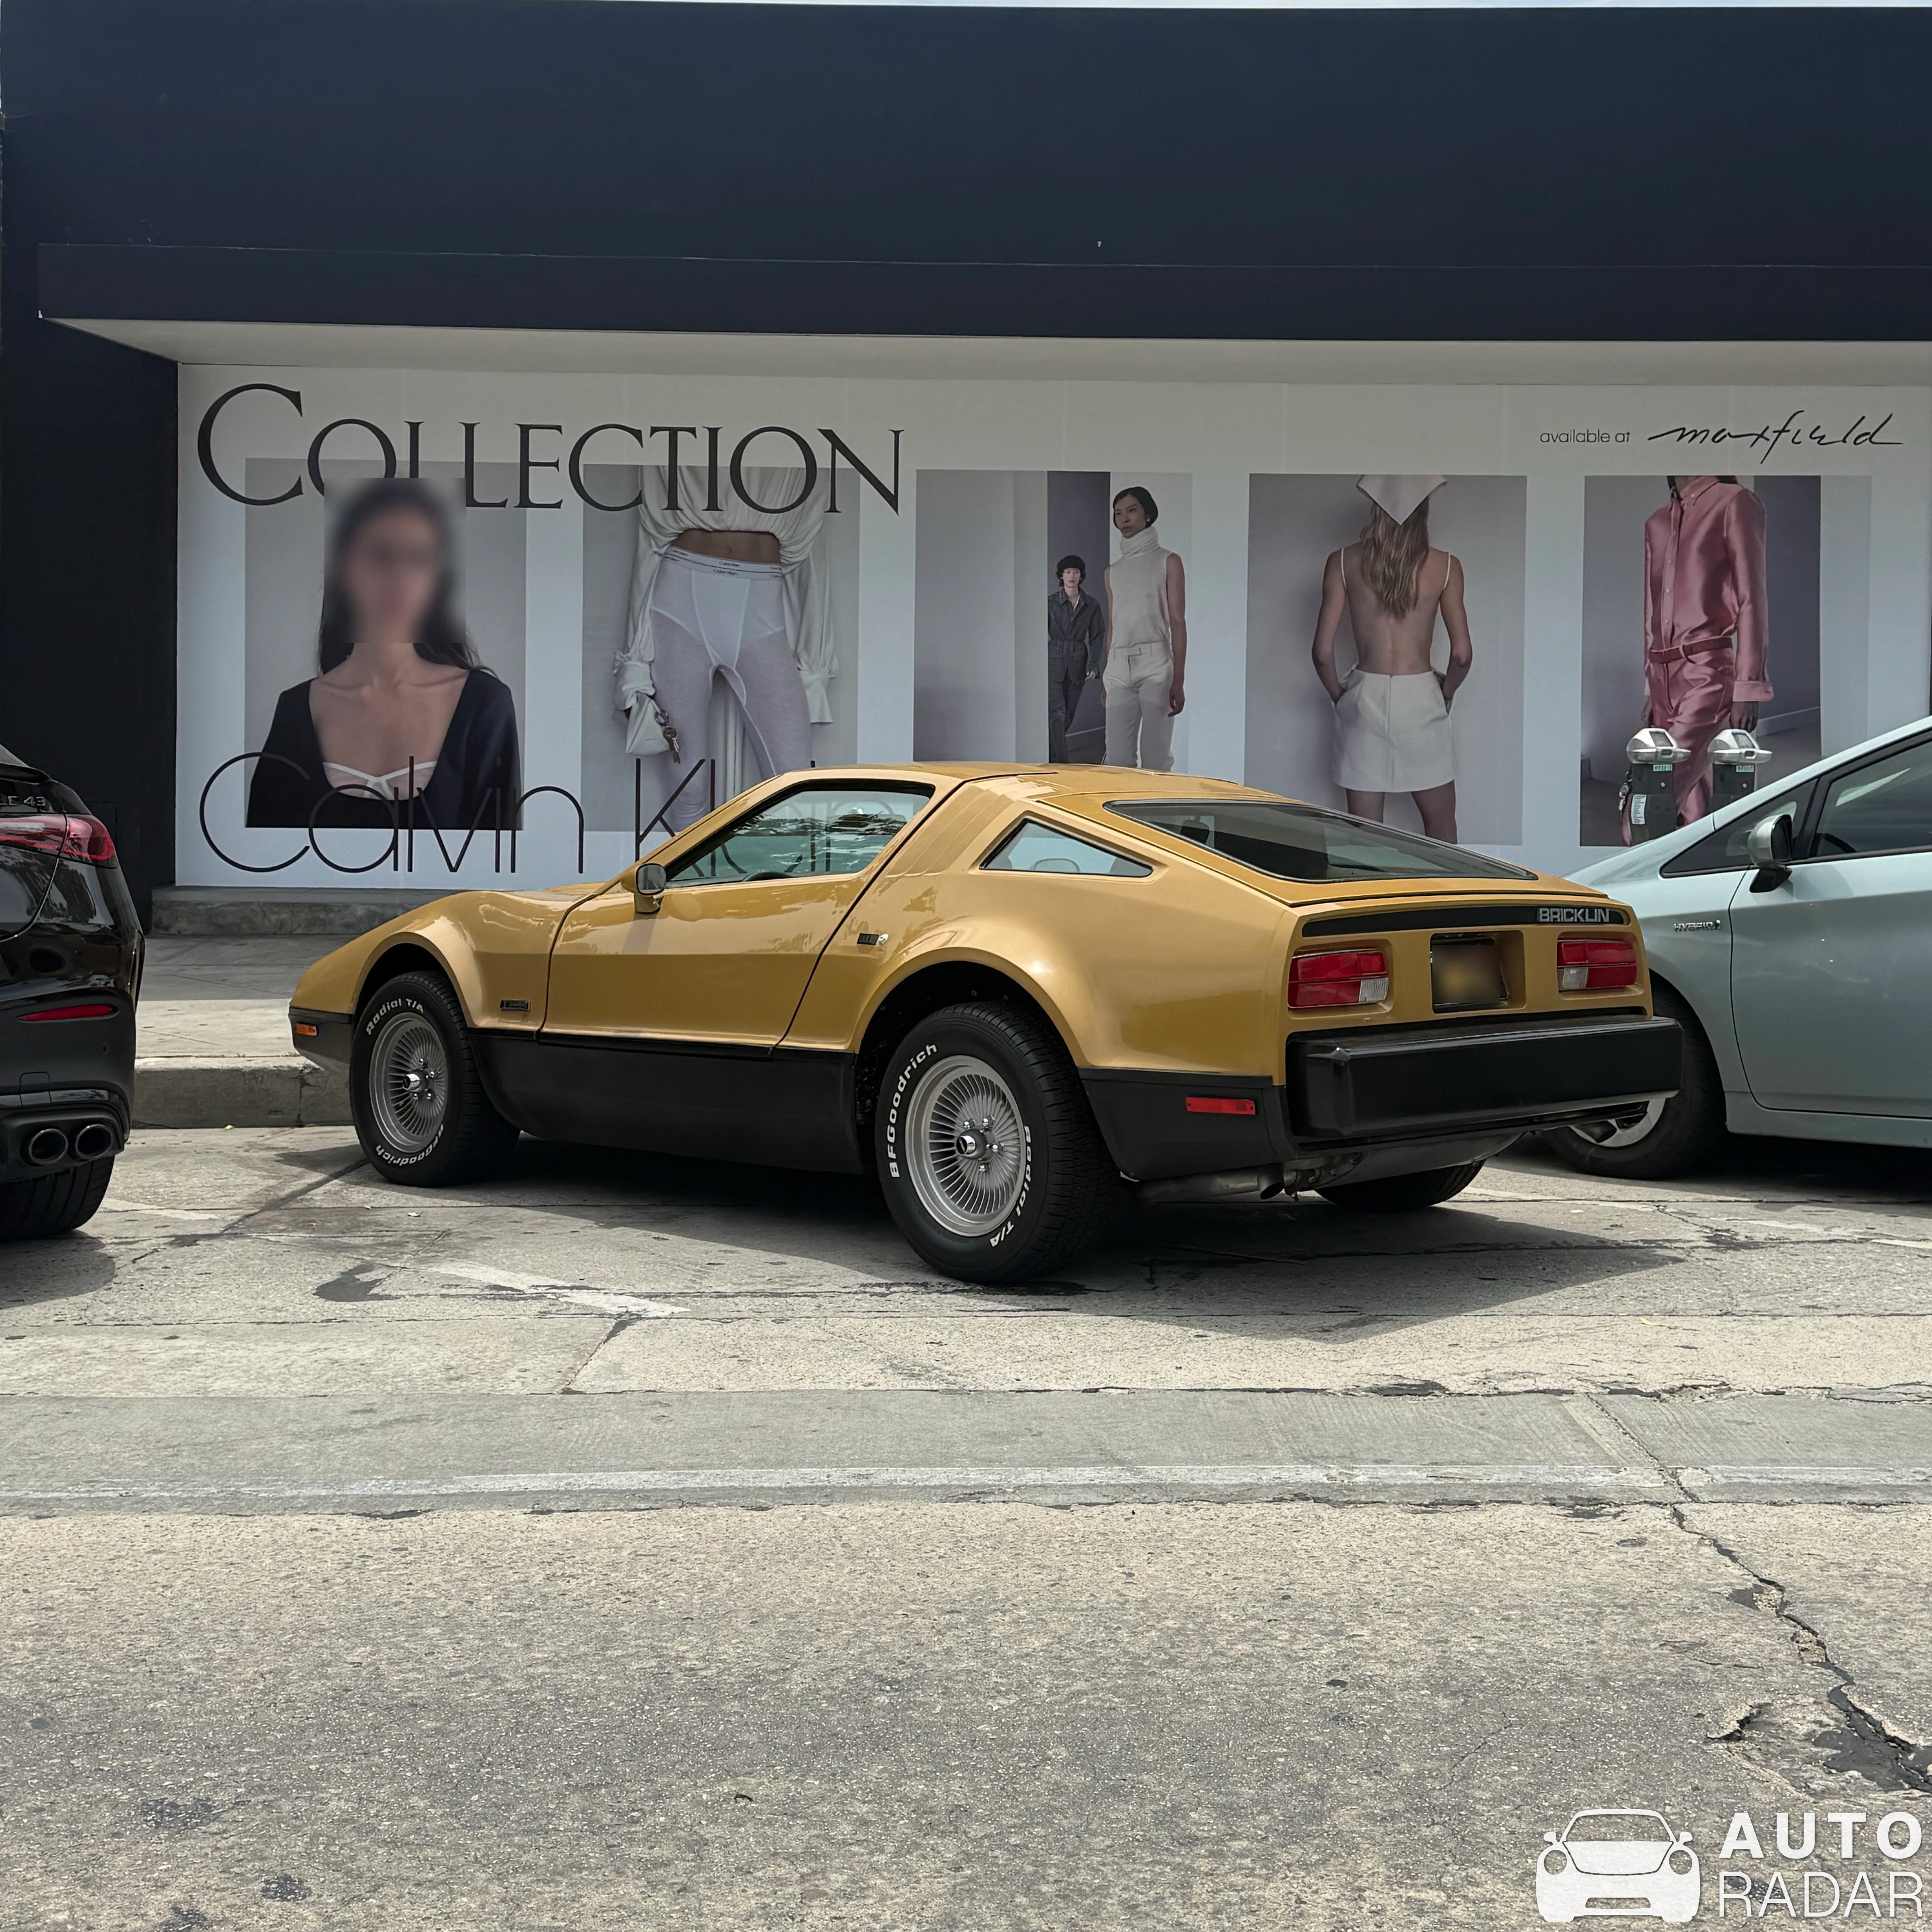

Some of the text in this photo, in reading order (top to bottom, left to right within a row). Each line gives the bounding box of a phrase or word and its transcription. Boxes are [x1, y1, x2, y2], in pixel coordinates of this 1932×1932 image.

[1540, 429, 1610, 443] available
[1615, 430, 1631, 443] at
[23, 796, 45, 806] 43
[200, 752, 584, 874] Calvin
[1539, 907, 1610, 923] BRICKLIN
[1674, 922, 1714, 931] HYBRID
[366, 998, 424, 1035] Radial T/A
[887, 1045, 937, 1177] BFGoodrich
[989, 1126, 1032, 1247] Radial T/A
